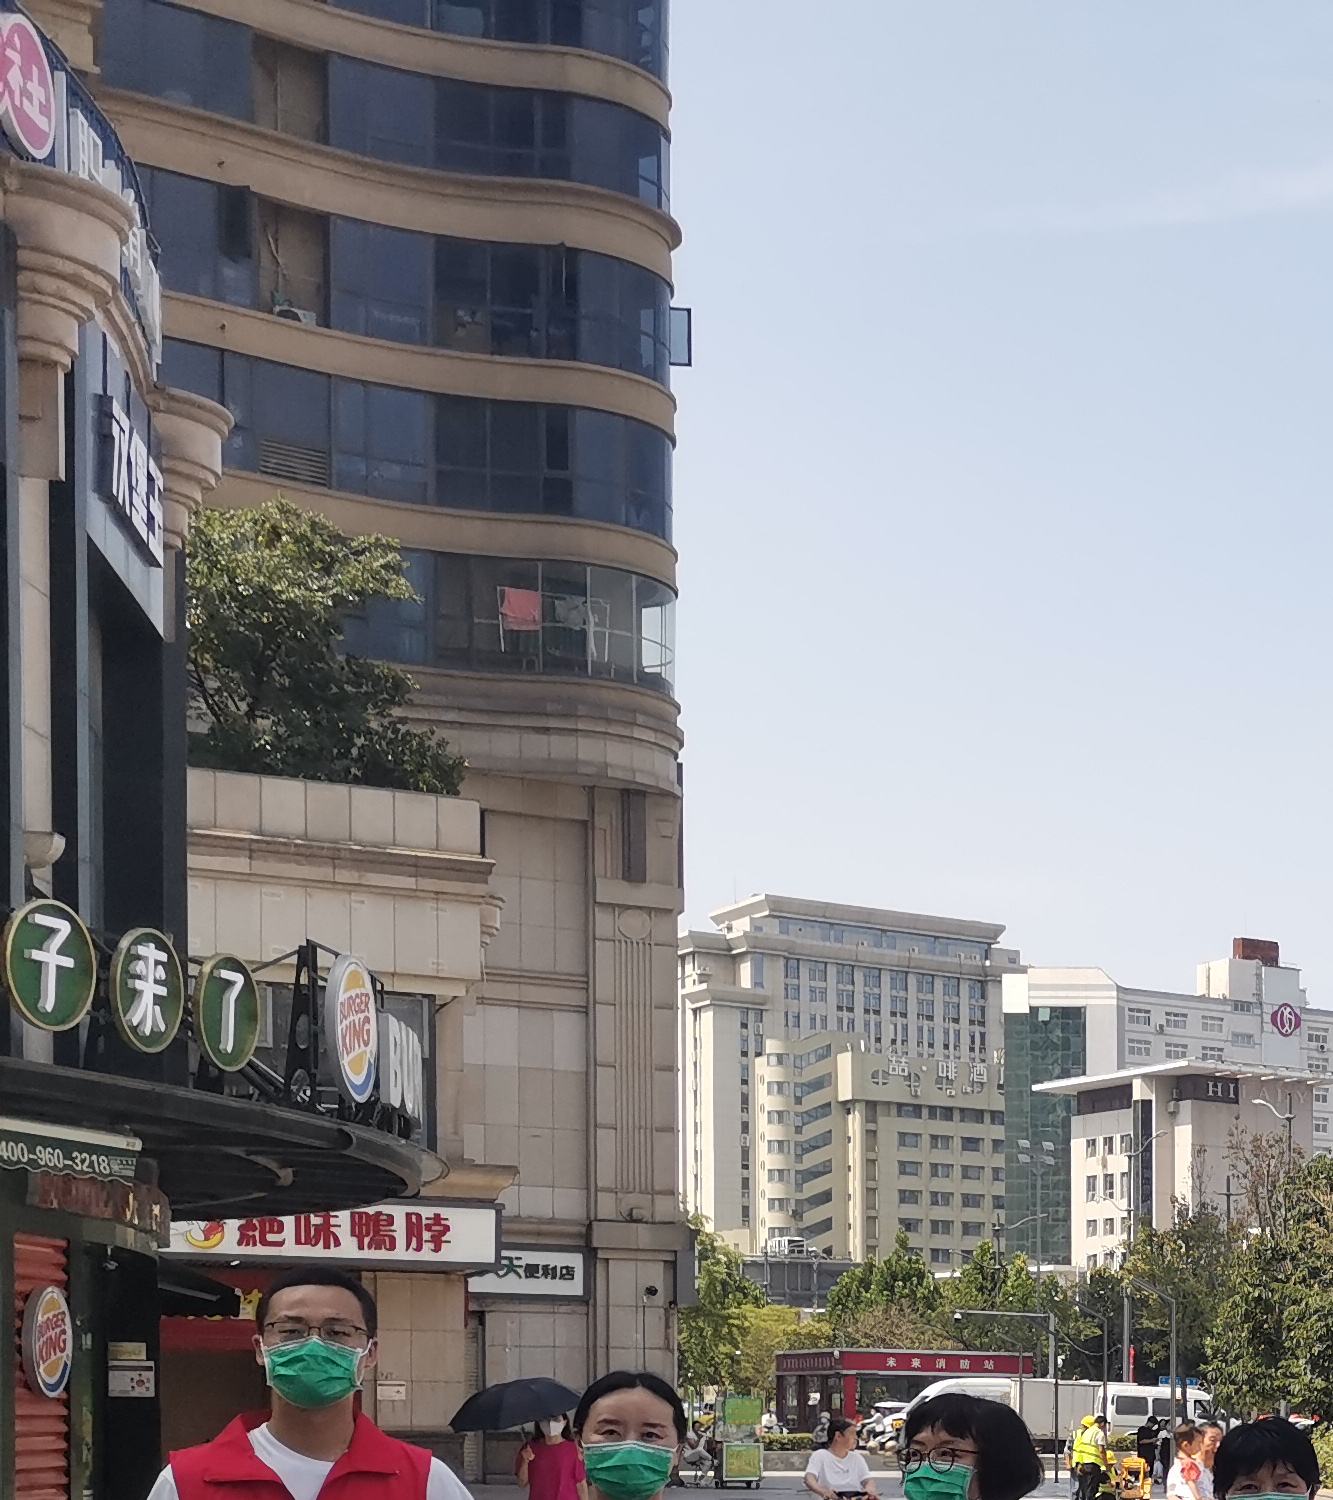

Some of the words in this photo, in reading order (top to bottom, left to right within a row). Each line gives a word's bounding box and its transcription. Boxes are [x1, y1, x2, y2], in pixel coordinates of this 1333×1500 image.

[24, 912, 246, 1054] 子来了
[339, 992, 371, 1025] BURGER
[340, 1013, 372, 1056] KING
[888, 1055, 1004, 1083] 喆·啡酒
[494, 1256, 575, 1281] 天便利店
[38, 1329, 67, 1364] KING
